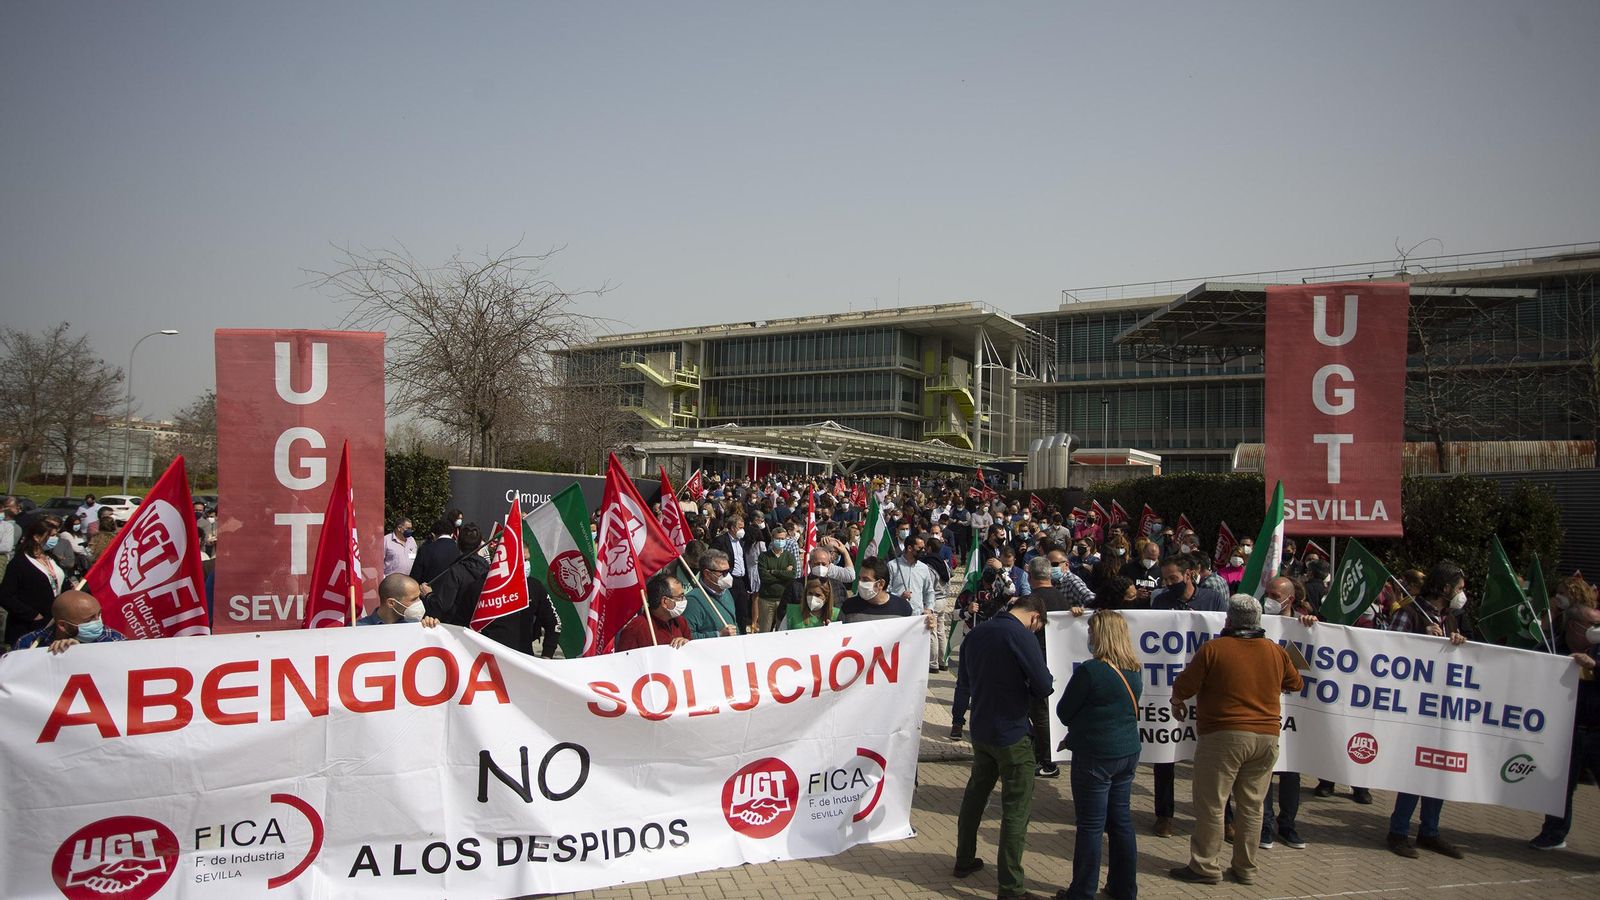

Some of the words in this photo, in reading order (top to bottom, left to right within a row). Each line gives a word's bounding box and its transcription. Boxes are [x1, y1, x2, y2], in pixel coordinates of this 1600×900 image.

[1312, 295, 1358, 484] UGT
[274, 342, 328, 575] UGT
[505, 489, 552, 507] Cmpus
[1282, 499, 1388, 521] SEVILLA
[1342, 558, 1364, 601] CSIF
[229, 594, 304, 621] SEVI
[1140, 631, 1358, 673] COMISO
[1370, 654, 1434, 683] CON
[1446, 663, 1480, 690] EL
[587, 637, 900, 721] SOLUCIÓN
[36, 647, 510, 743] ABENGOA
[1350, 684, 1408, 713] DEL
[1418, 692, 1546, 732] EMPLEO
[1351, 737, 1375, 751] UGT
[477, 741, 590, 803] NO
[1420, 752, 1465, 768] CCOO
[1508, 762, 1537, 776] CSIF
[733, 769, 788, 798] UGT
[808, 767, 869, 794] FICA
[809, 799, 817, 808] F.
[819, 799, 830, 807] de
[810, 809, 844, 820] SEVILLA
[195, 818, 286, 850] FICA
[348, 845, 381, 878] A
[393, 837, 482, 876] LOS
[496, 819, 690, 867] DESPIDOS
[70, 829, 164, 872] UGT
[195, 856, 206, 867] F.
[210, 855, 227, 865] de
[231, 851, 285, 864] Industria
[195, 870, 242, 884] SEVILLA
